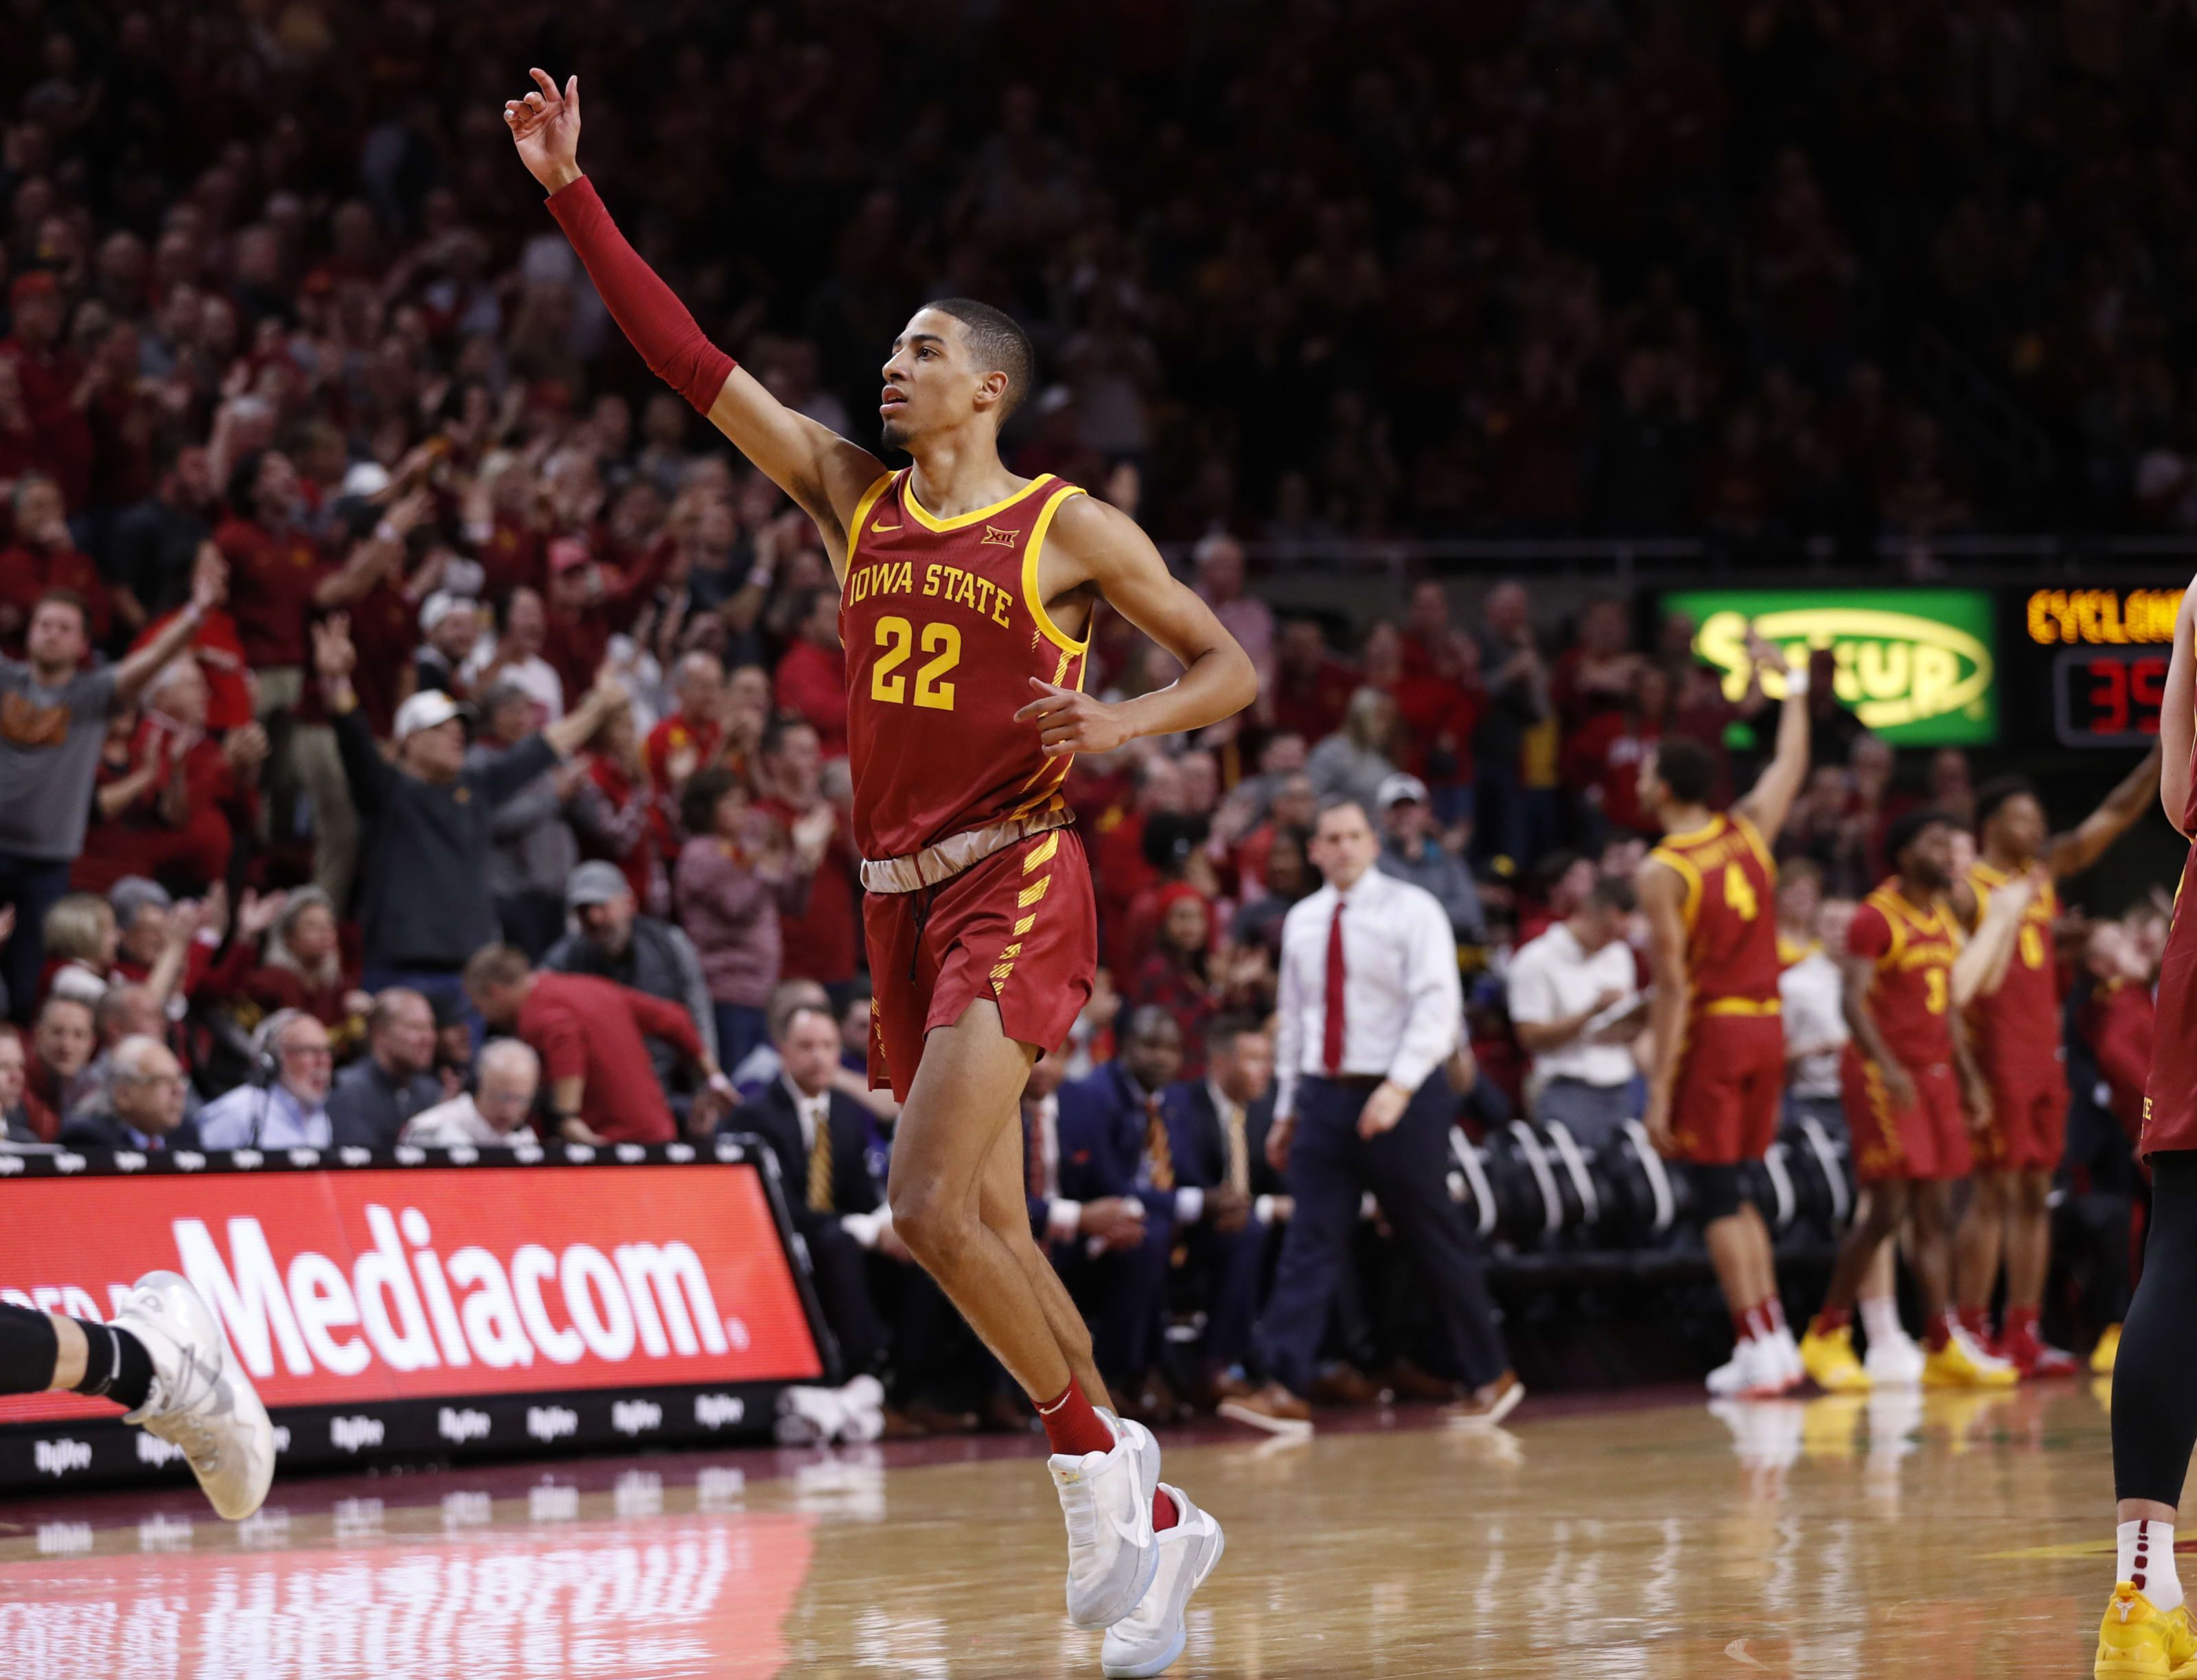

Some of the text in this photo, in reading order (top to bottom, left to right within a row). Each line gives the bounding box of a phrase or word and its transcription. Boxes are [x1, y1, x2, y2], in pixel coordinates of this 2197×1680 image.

[849, 561, 1013, 630] IOWA STATE
[871, 615, 962, 711] 22
[1724, 860, 1758, 921] 4
[1924, 966, 1946, 1015] 3
[172, 1203, 729, 1377] Mediacom
